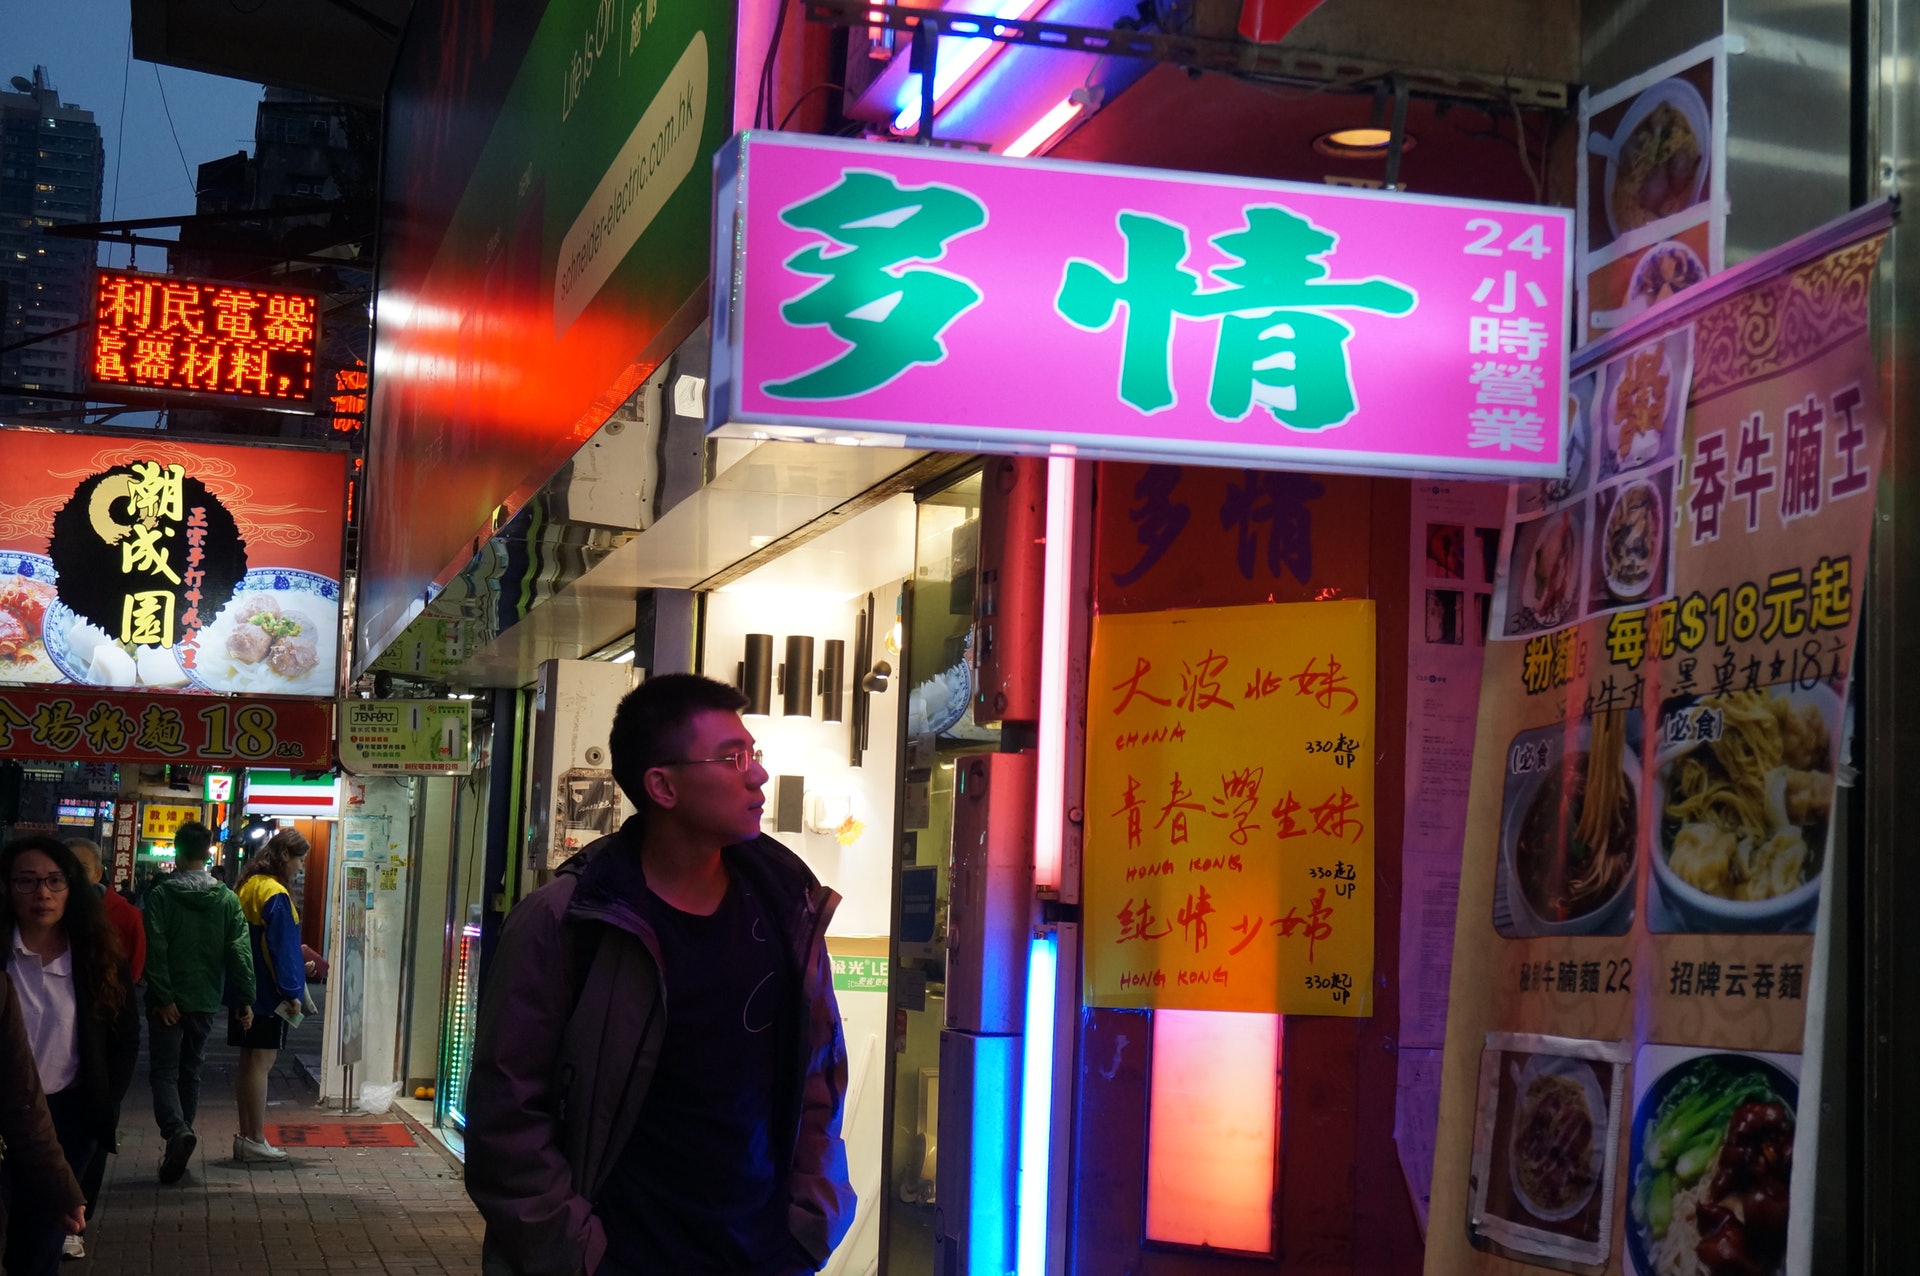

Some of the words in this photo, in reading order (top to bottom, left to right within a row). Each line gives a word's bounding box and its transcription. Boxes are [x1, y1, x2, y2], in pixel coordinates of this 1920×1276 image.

[560, 80, 694, 300] schneider-electric.com.hk
[103, 281, 311, 344] 利民電器
[761, 168, 1418, 433] 多情
[122, 460, 187, 649] 潮成園
[1335, 753, 1356, 769] UP
[1126, 858, 1175, 882] HONG
[1189, 854, 1243, 873] KONG
[1335, 882, 1356, 899] UP
[1119, 969, 1167, 991] HONG
[1177, 968, 1229, 988] KONG
[1333, 988, 1351, 1004] UP
[1669, 959, 1805, 1000] 招牌云吞麵
